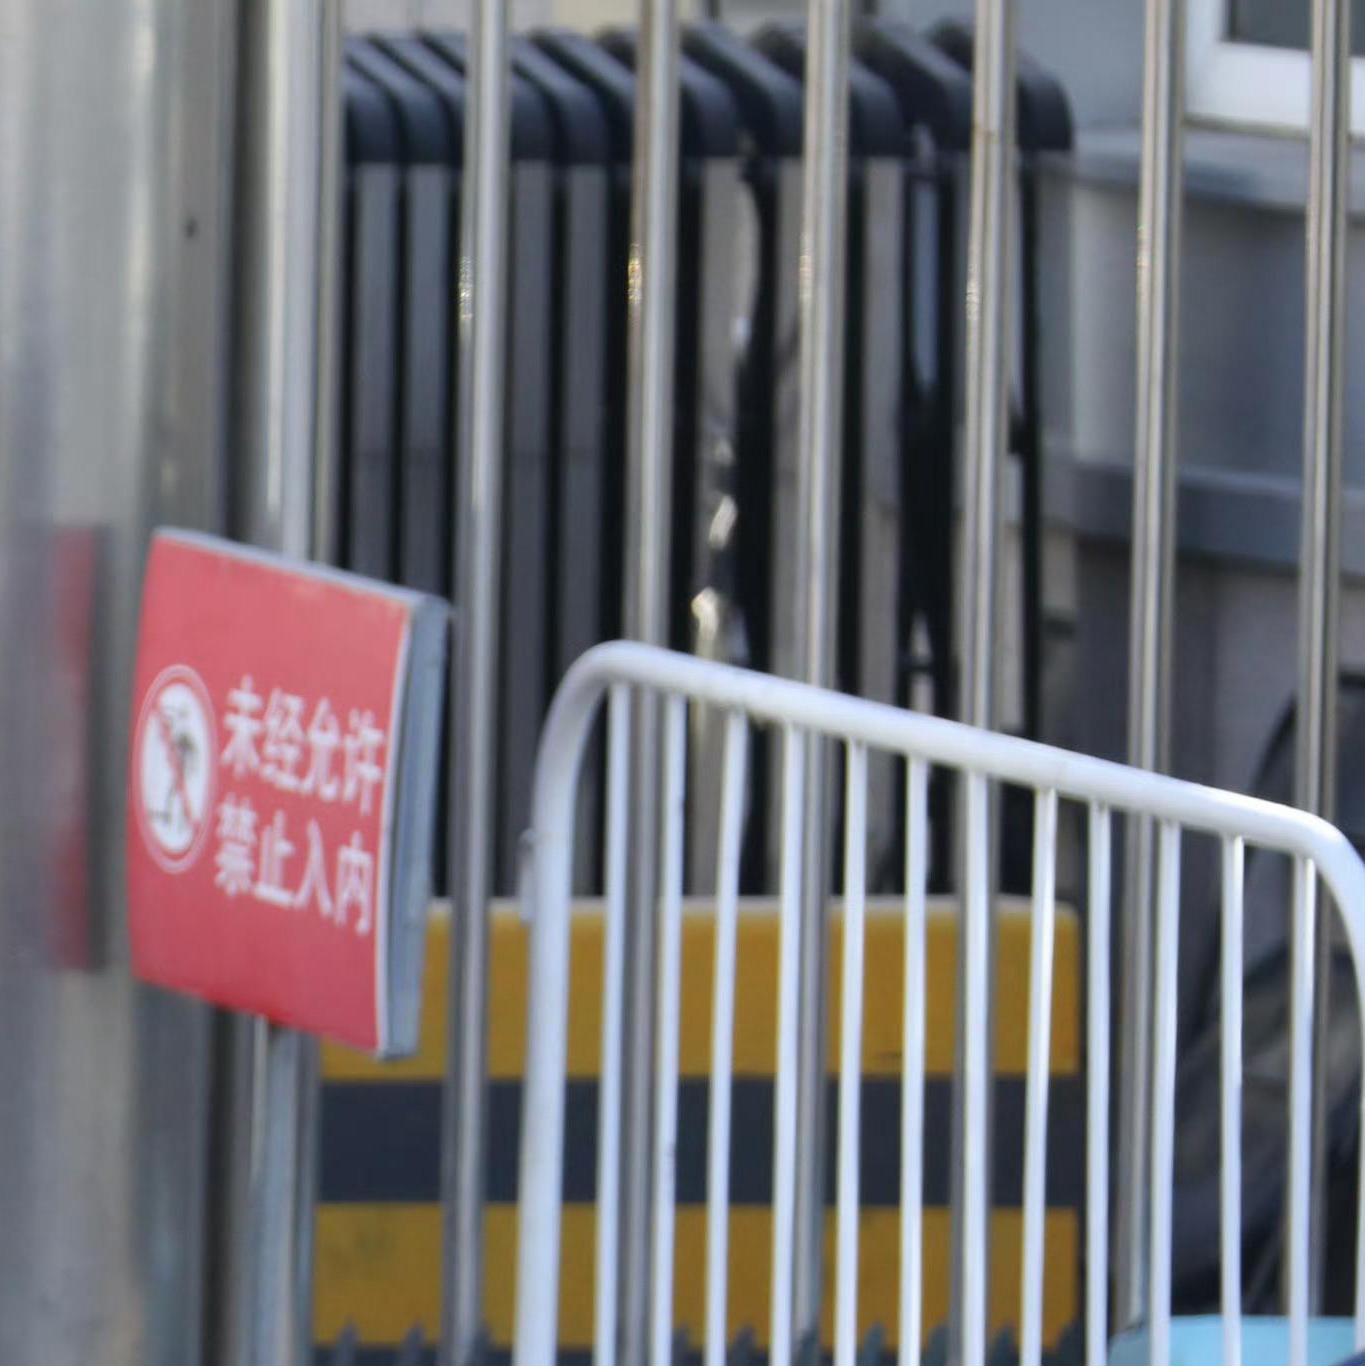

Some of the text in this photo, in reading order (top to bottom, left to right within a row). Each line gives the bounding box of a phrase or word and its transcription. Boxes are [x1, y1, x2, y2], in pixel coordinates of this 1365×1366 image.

[221, 674, 385, 817] 未经允许
[215, 794, 374, 935] 禁止入内
